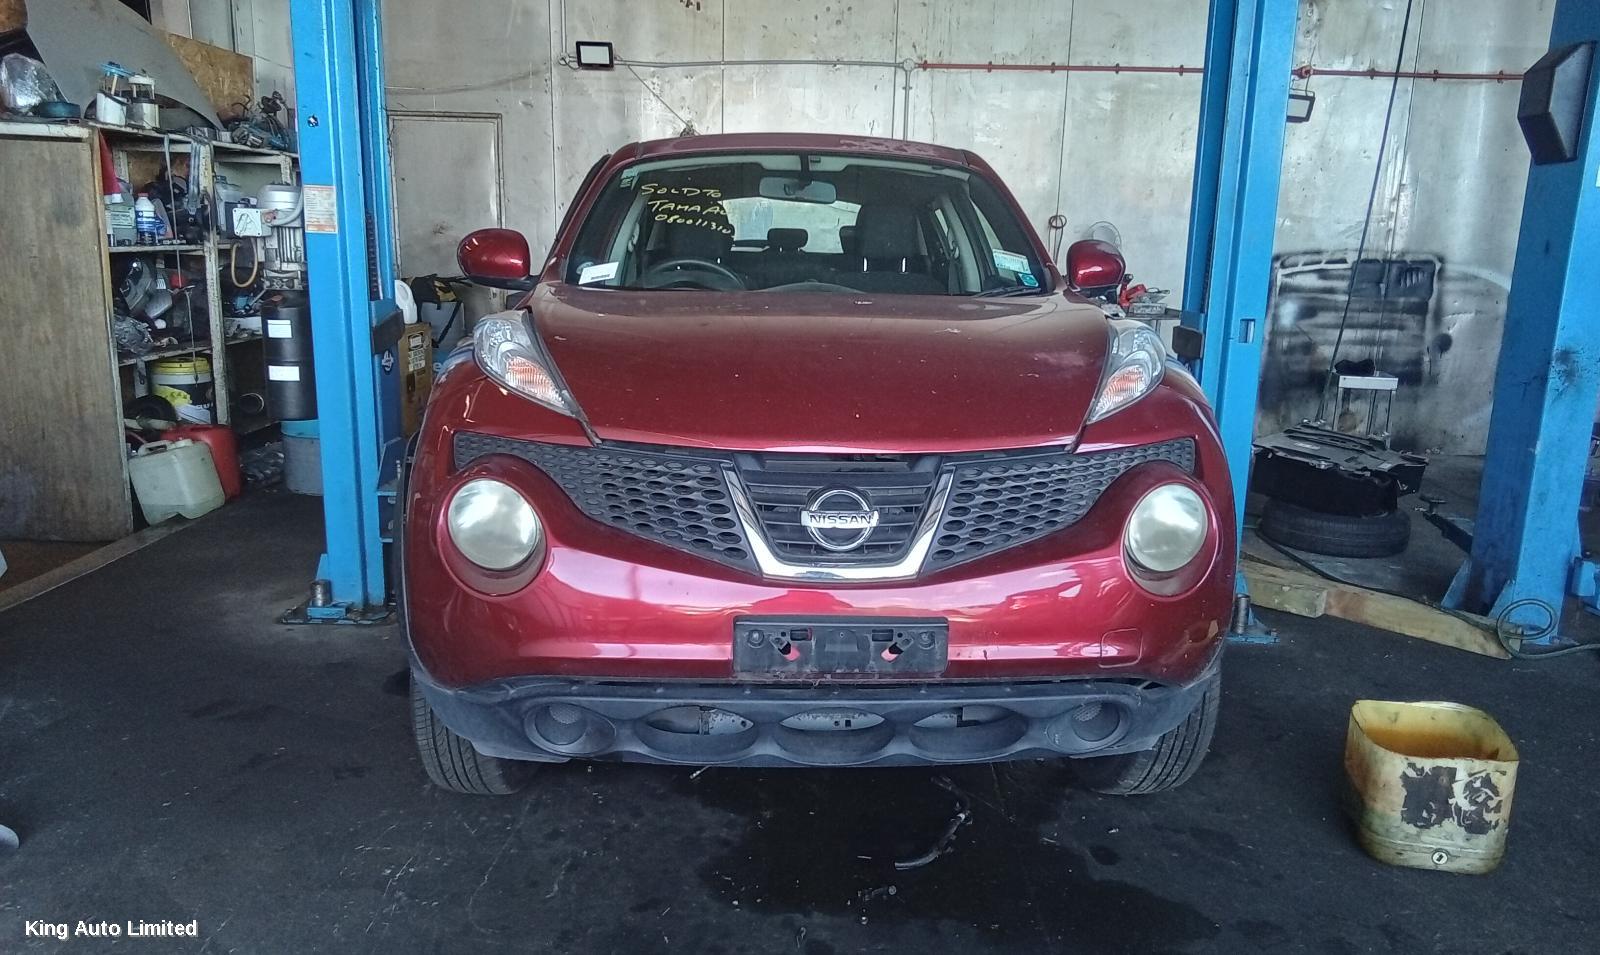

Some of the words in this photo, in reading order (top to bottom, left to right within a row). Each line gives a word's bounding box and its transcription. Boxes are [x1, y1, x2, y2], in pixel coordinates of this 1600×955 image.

[641, 183, 701, 197] SOLD
[647, 200, 701, 213] TAMA
[809, 513, 872, 525] NISSAN
